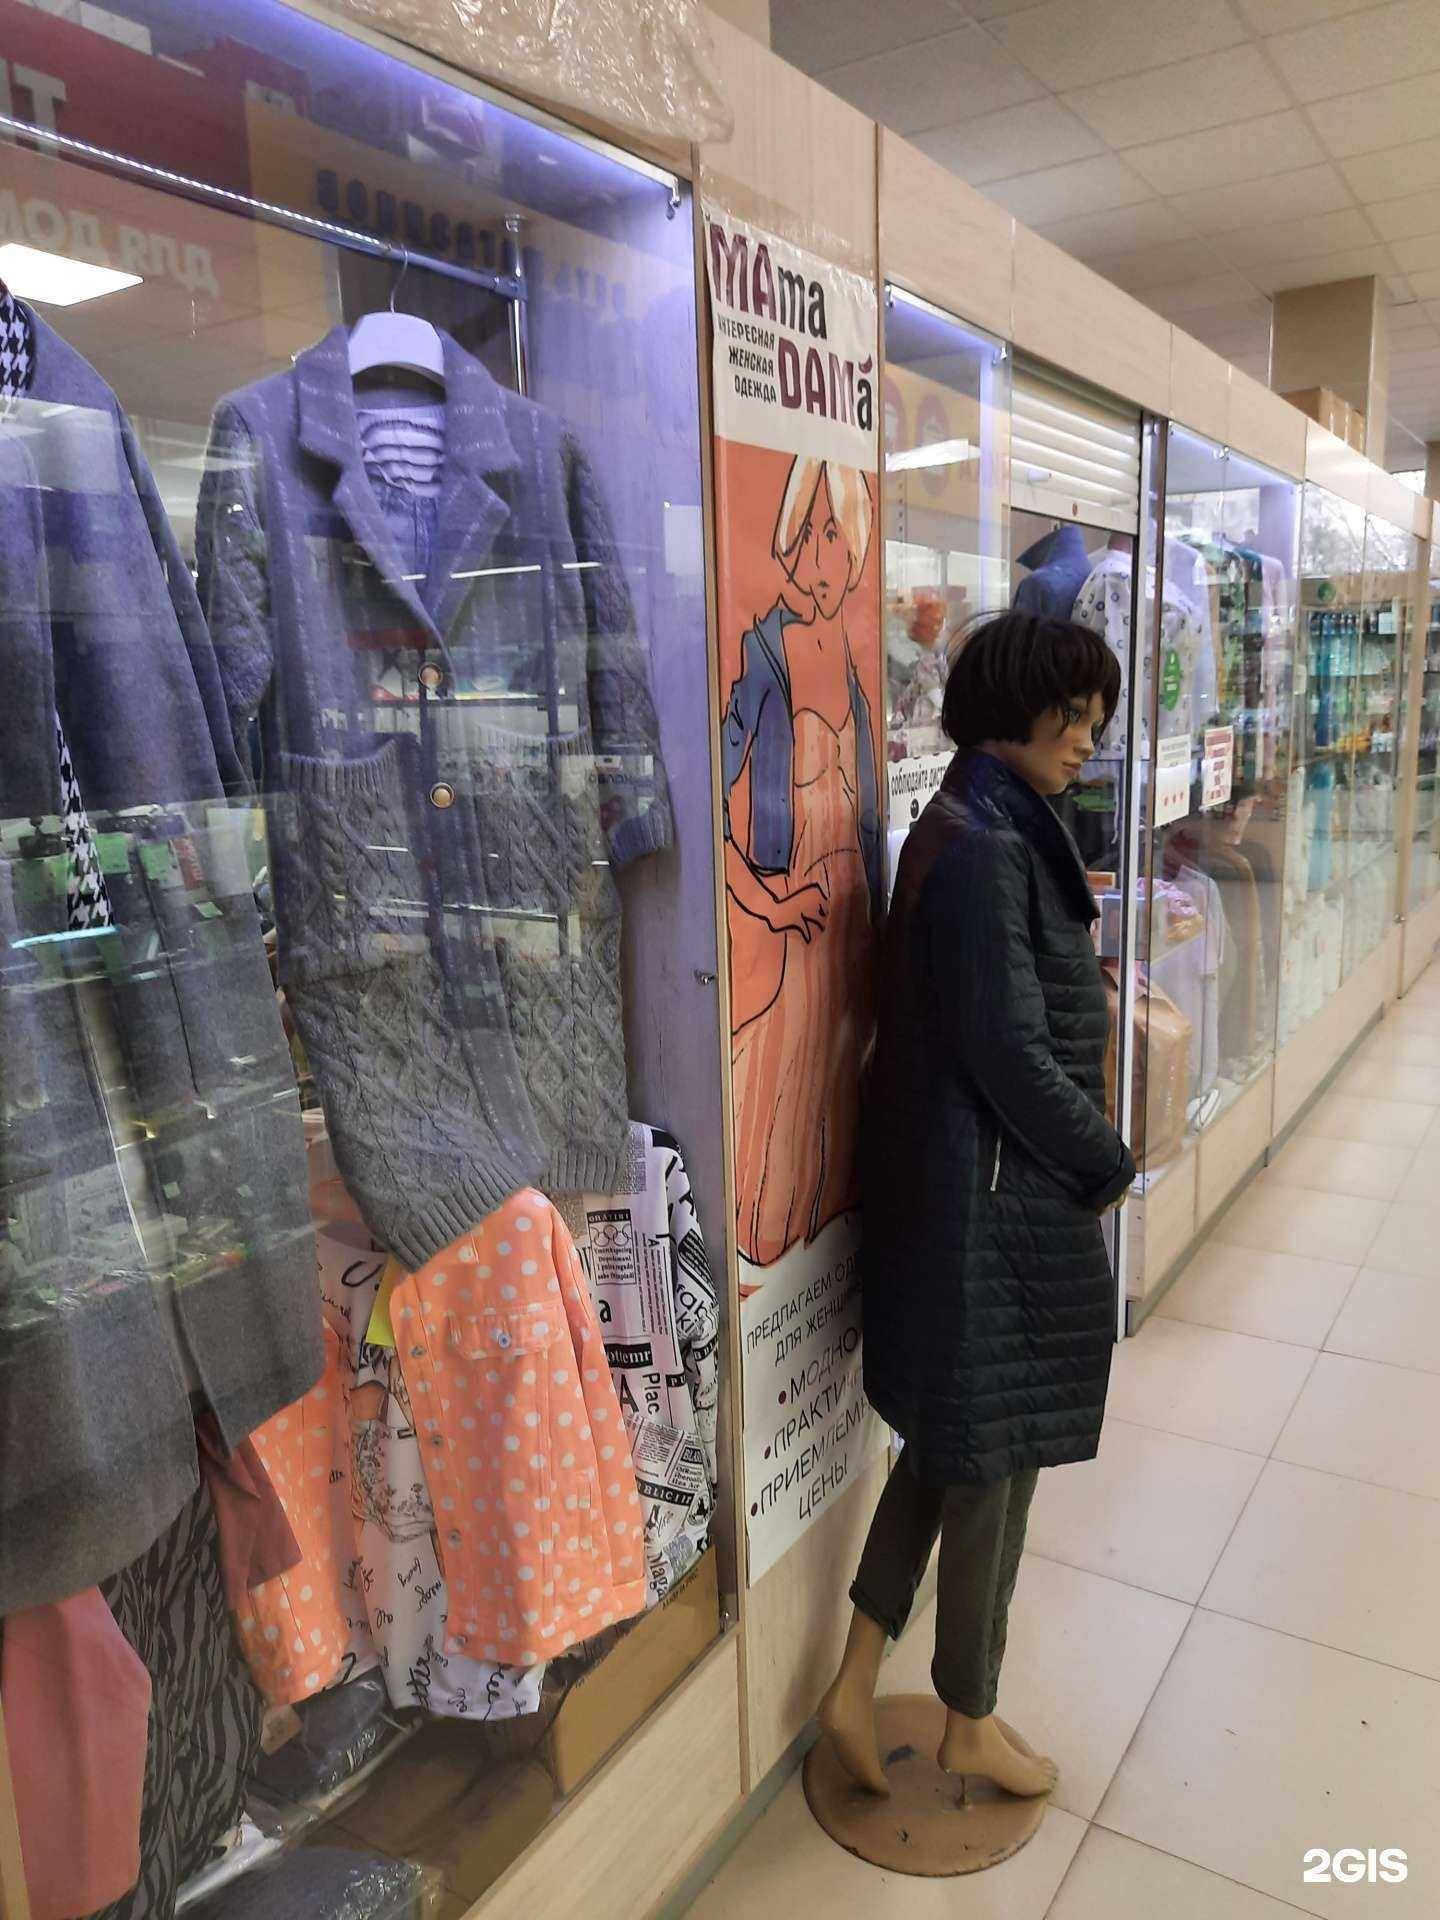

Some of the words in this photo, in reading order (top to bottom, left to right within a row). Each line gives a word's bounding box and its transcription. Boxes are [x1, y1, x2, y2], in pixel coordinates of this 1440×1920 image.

[728, 345, 774, 378] ЖЕНСКАЯ
[734, 374, 777, 404] ОДЕЖДА
[746, 1271, 832, 1355] ПРЕДЛАГАЕМ
[775, 1326, 803, 1368] ДЛЯ
[799, 1453, 848, 1521] ЦЕНЫ
